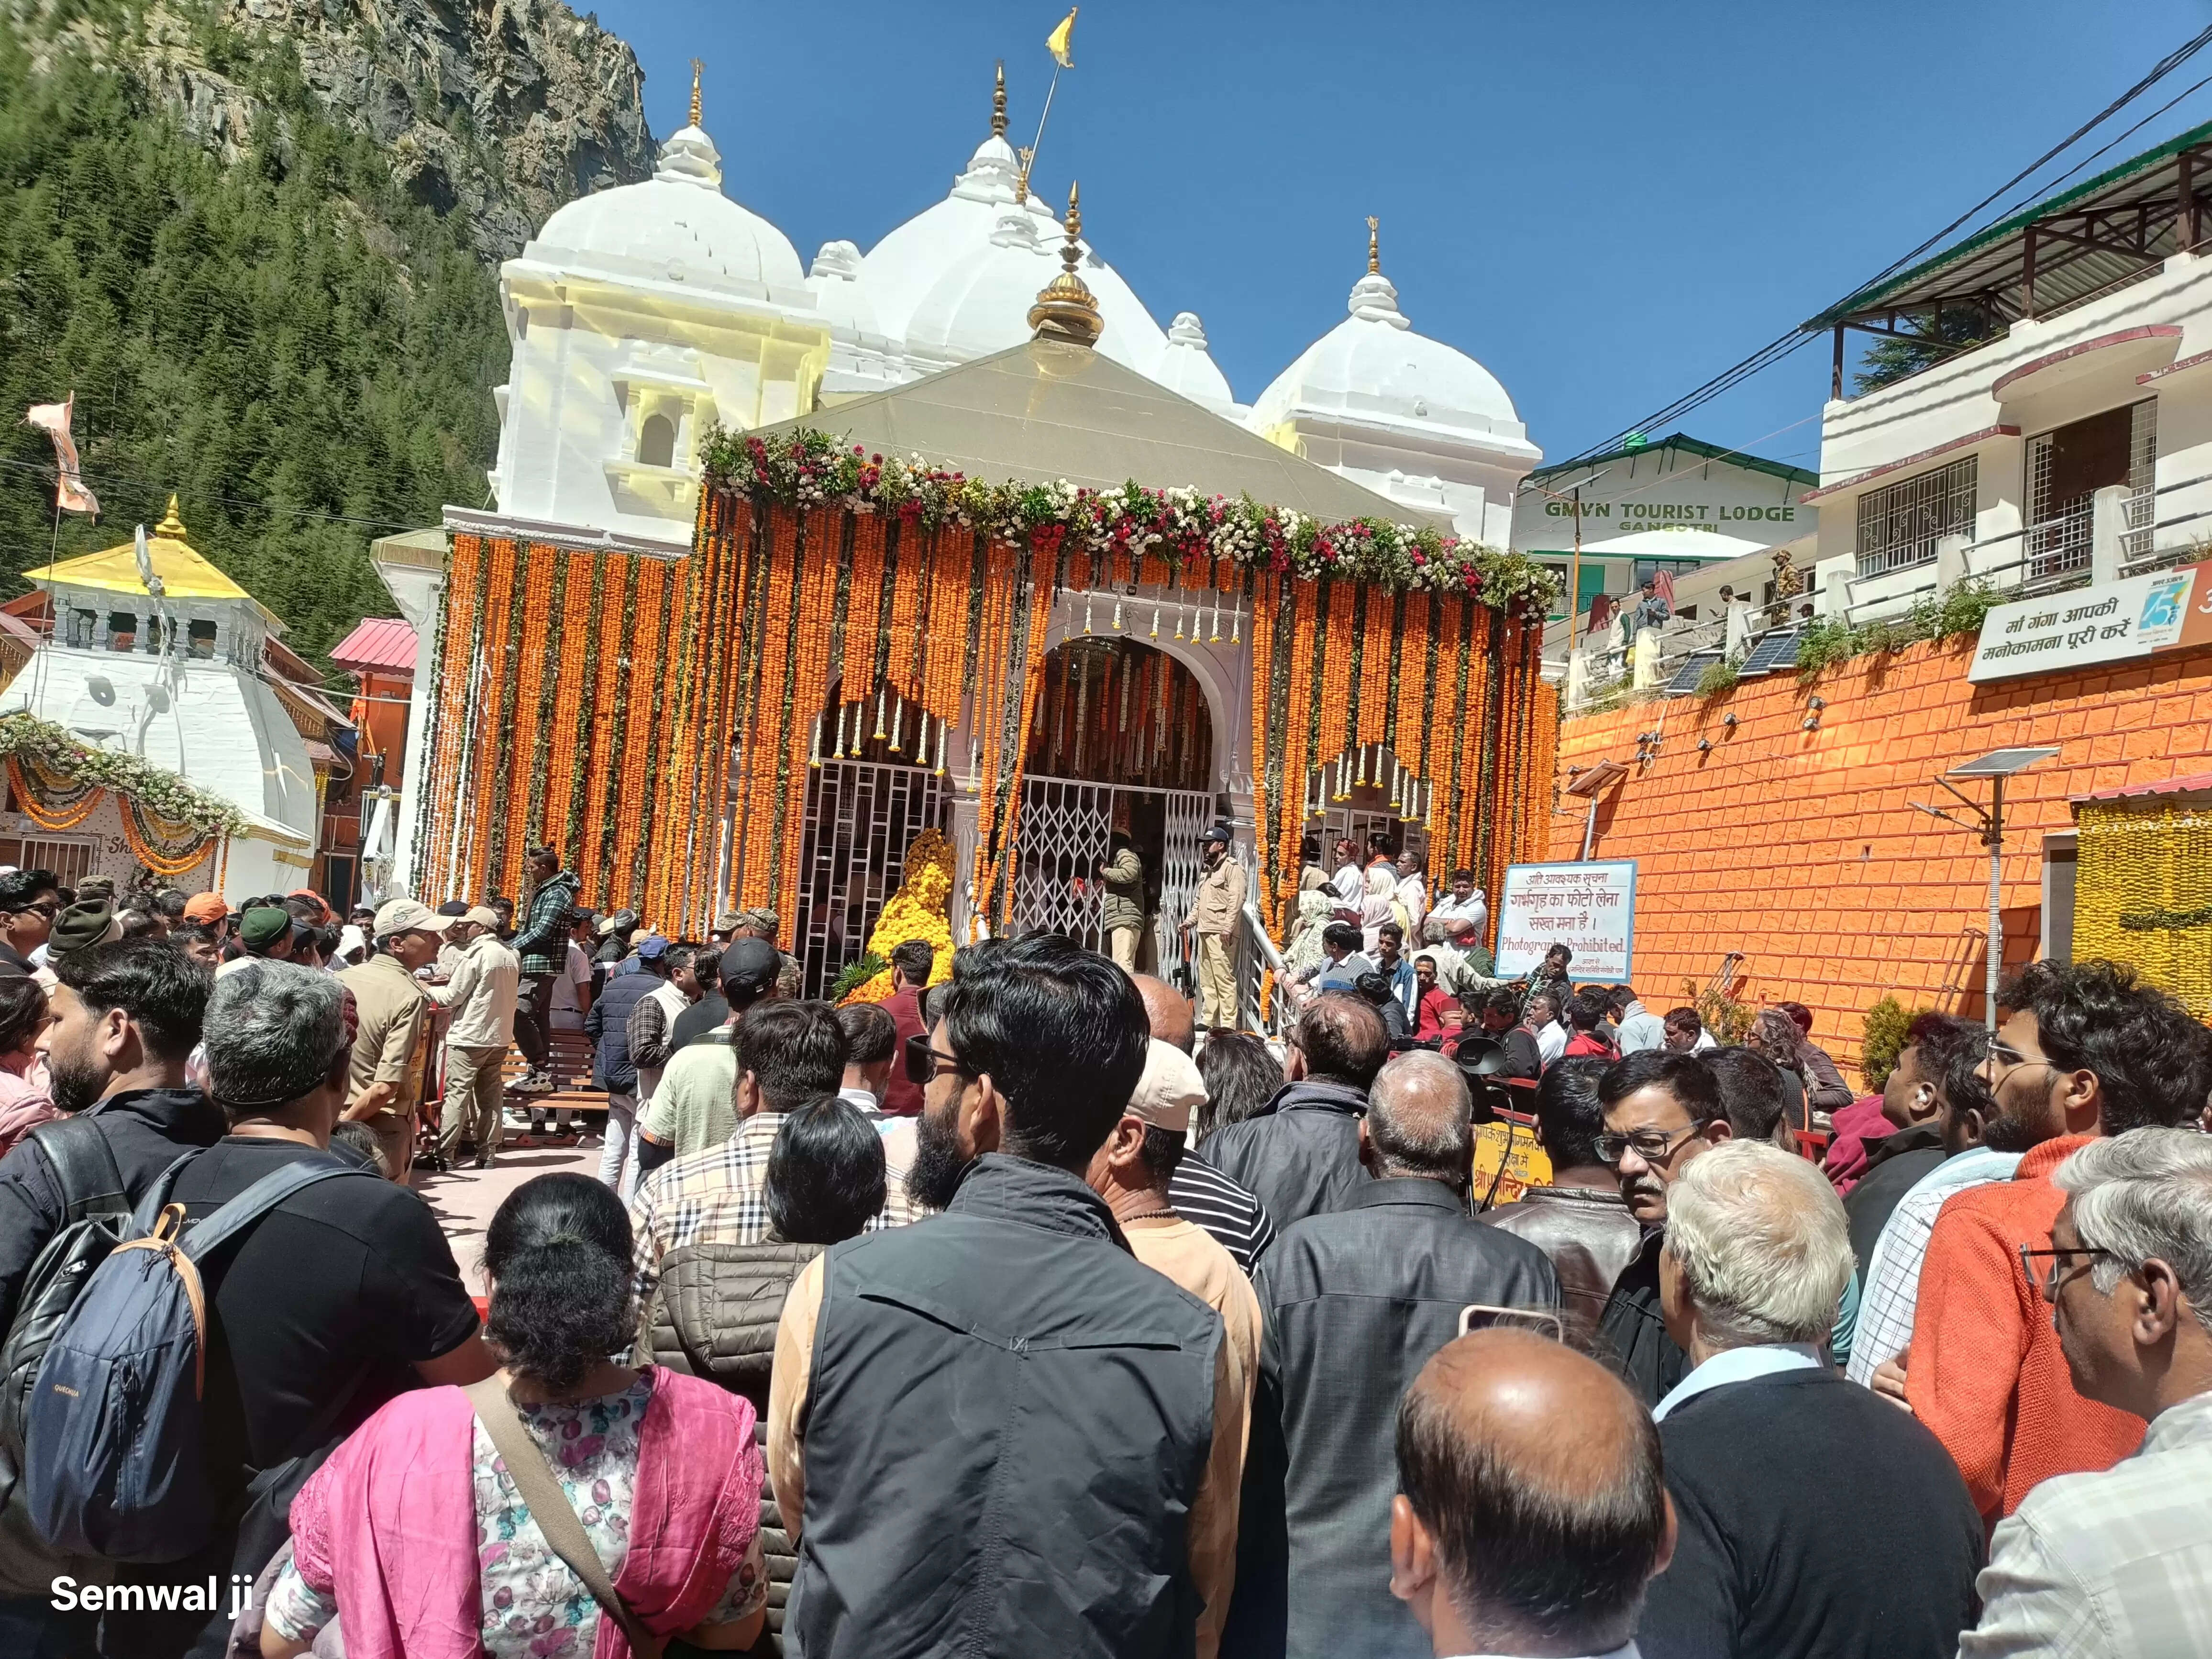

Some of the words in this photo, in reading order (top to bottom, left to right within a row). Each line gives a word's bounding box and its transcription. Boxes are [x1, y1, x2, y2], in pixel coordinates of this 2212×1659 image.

[1545, 502, 1610, 517] GMVN
[1621, 503, 1709, 520] TOURIST
[1720, 506, 1794, 522] LODGE
[1619, 521, 1718, 533] GANGOTRI
[2028, 611, 2059, 629] गंगा
[2062, 597, 2119, 623] आपकी
[1982, 635, 2064, 660] मनोकामना
[2068, 625, 2097, 649] पूरी
[2100, 618, 2132, 640] करें
[1526, 872, 1543, 885] अति
[1544, 873, 1582, 885] आवश्यक
[1583, 873, 1608, 887] सूचना
[1510, 889, 1548, 913] गर्भगृह
[1549, 893, 1564, 907] का
[1567, 888, 1594, 907] फोटो
[1596, 888, 1620, 907] लेना
[1528, 917, 1555, 931] सख्त
[1556, 917, 1575, 930] मना
[1577, 911, 1588, 931] है
[1501, 937, 1565, 955] Photograph
[1520, 1152, 1528, 1168] में
[1475, 1164, 1486, 1190] श्री
[55, 1384, 79, 1397] QUECHUA
